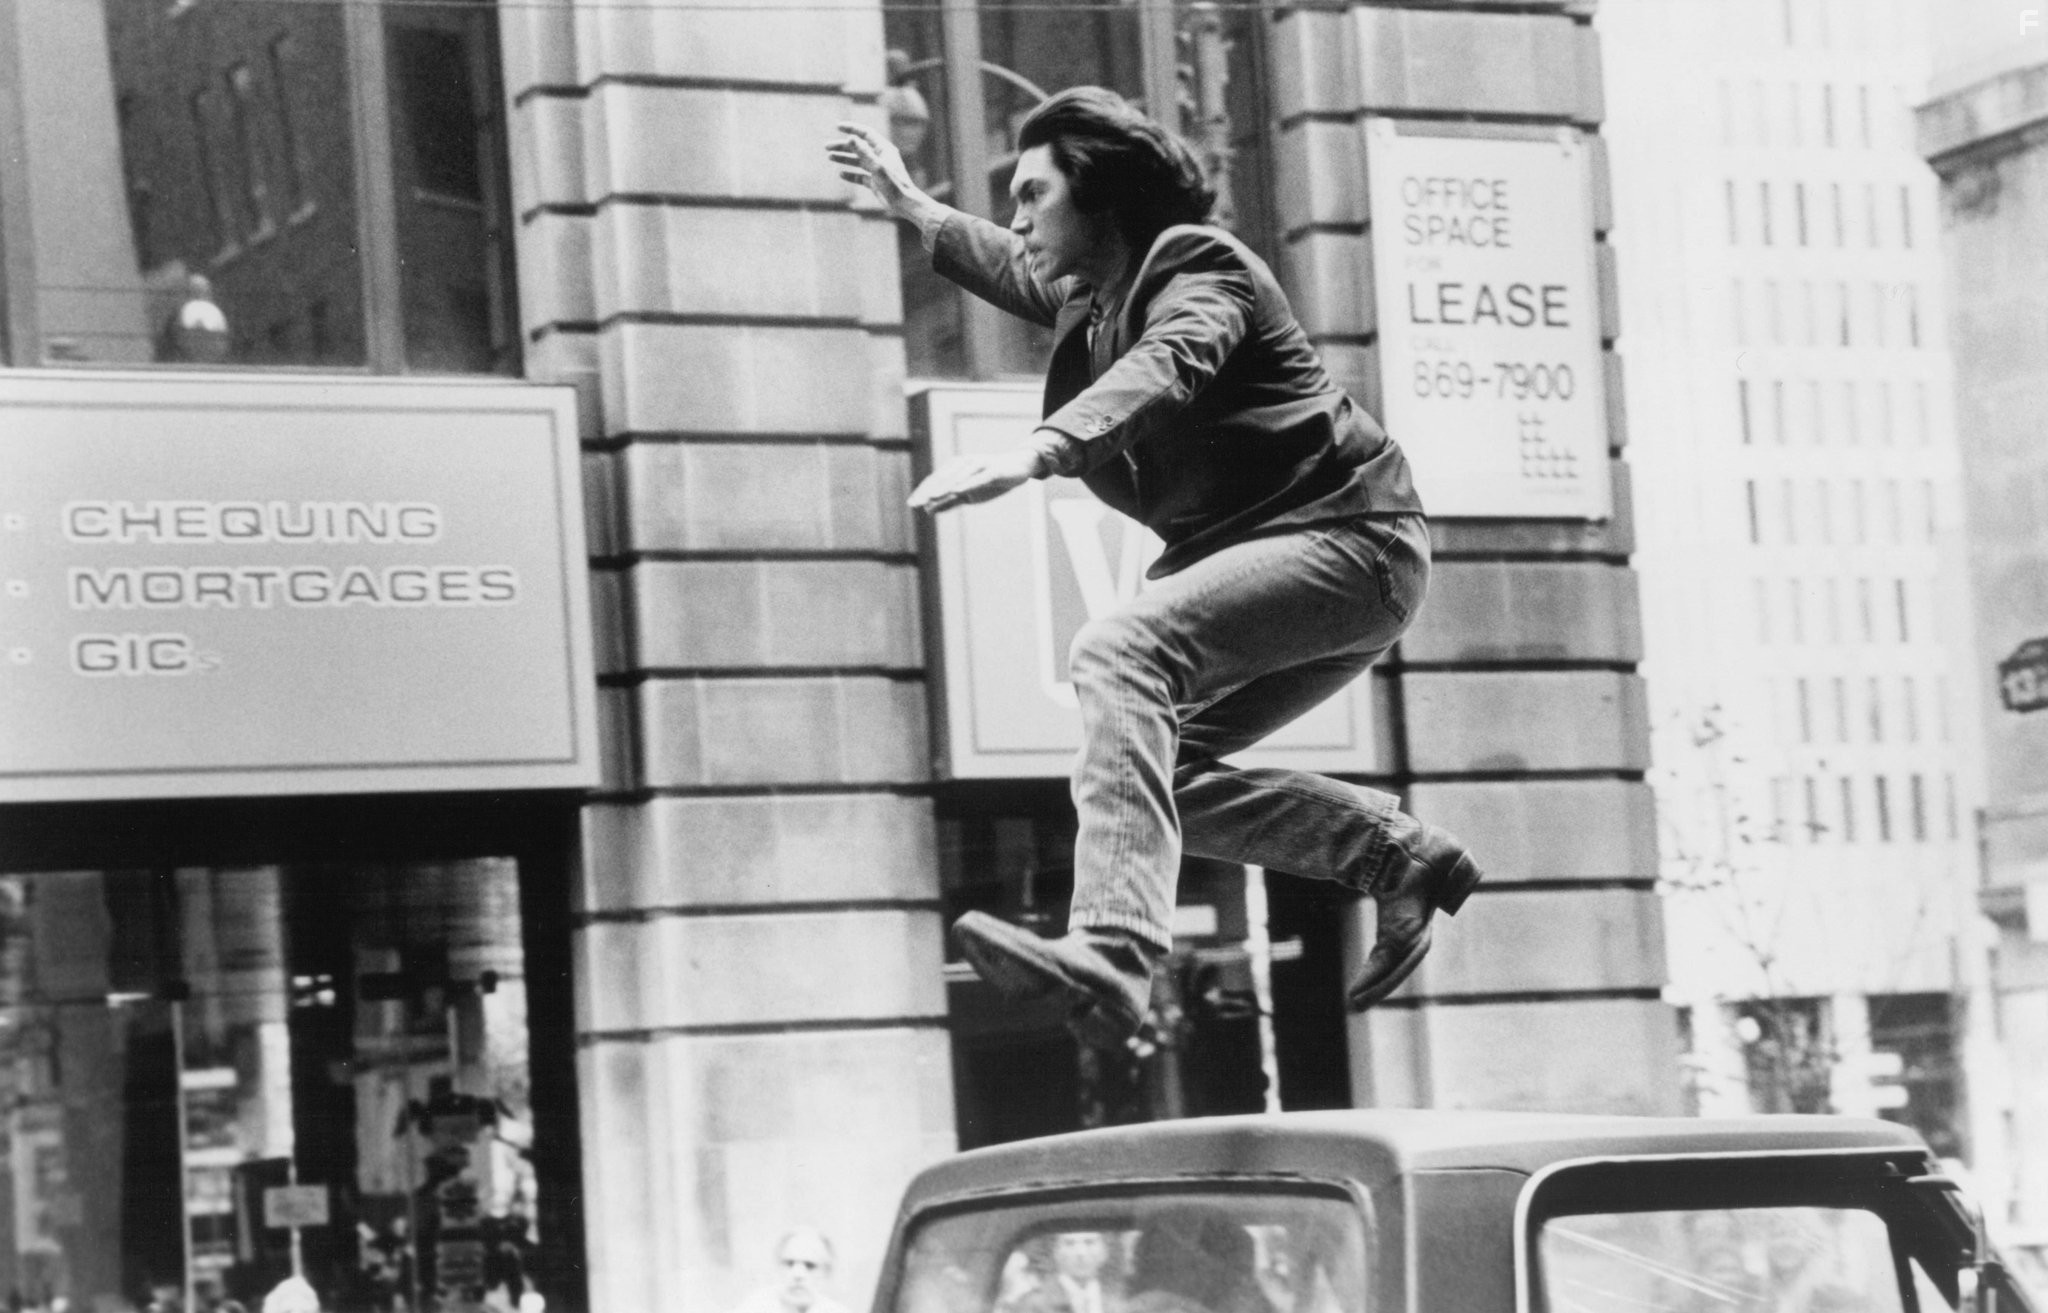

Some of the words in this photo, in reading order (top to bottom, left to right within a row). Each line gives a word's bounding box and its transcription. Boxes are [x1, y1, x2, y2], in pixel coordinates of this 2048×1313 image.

[1403, 176, 1508, 210] OFFICE
[1405, 214, 1511, 248] SPACE
[1408, 282, 1569, 328] LEASE
[1413, 360, 1574, 400] 869-7900
[66, 502, 441, 541] CHEQUING
[72, 567, 518, 605] MORTGAGES
